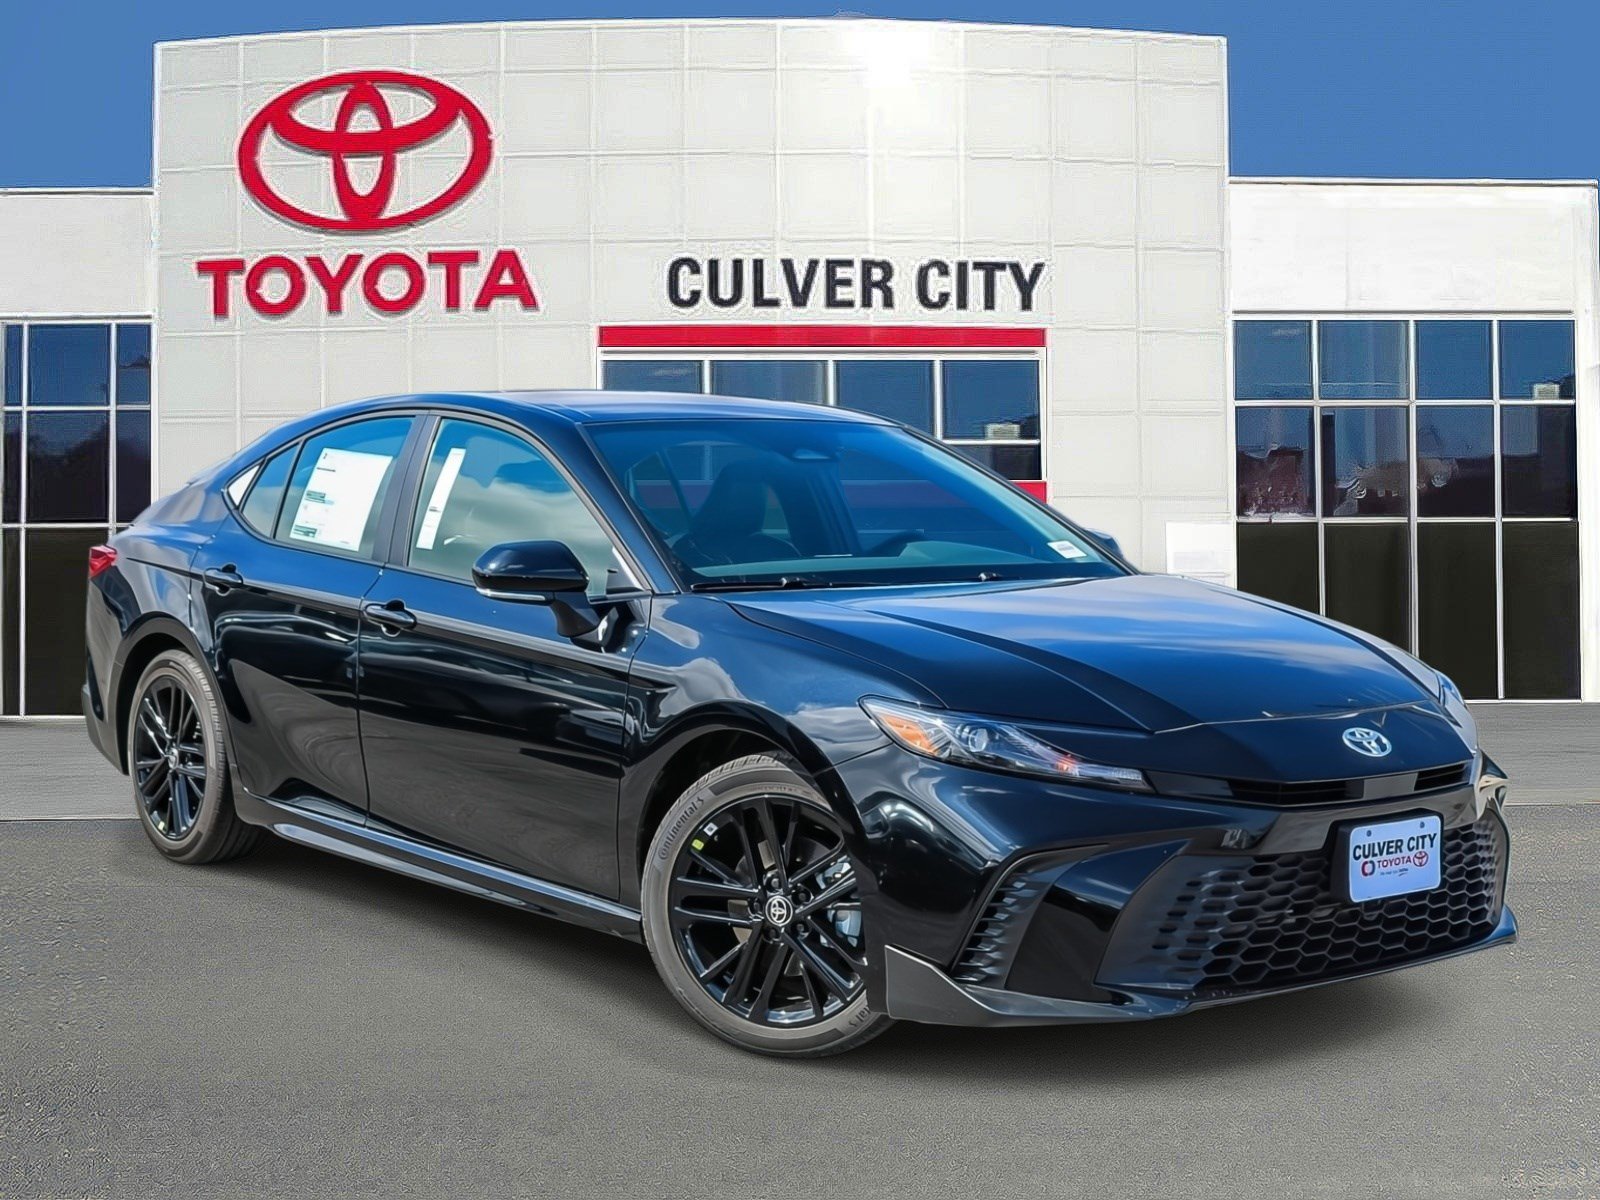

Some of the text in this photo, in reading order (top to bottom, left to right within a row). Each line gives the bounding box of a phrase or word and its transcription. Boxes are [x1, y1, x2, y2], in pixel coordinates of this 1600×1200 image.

[196, 250, 537, 317] TOYOTA
[668, 257, 1046, 311] CULVER CITY
[658, 801, 698, 860] Continental
[1353, 833, 1437, 860] CULVER CITY
[1377, 856, 1412, 868] TOYOTA
